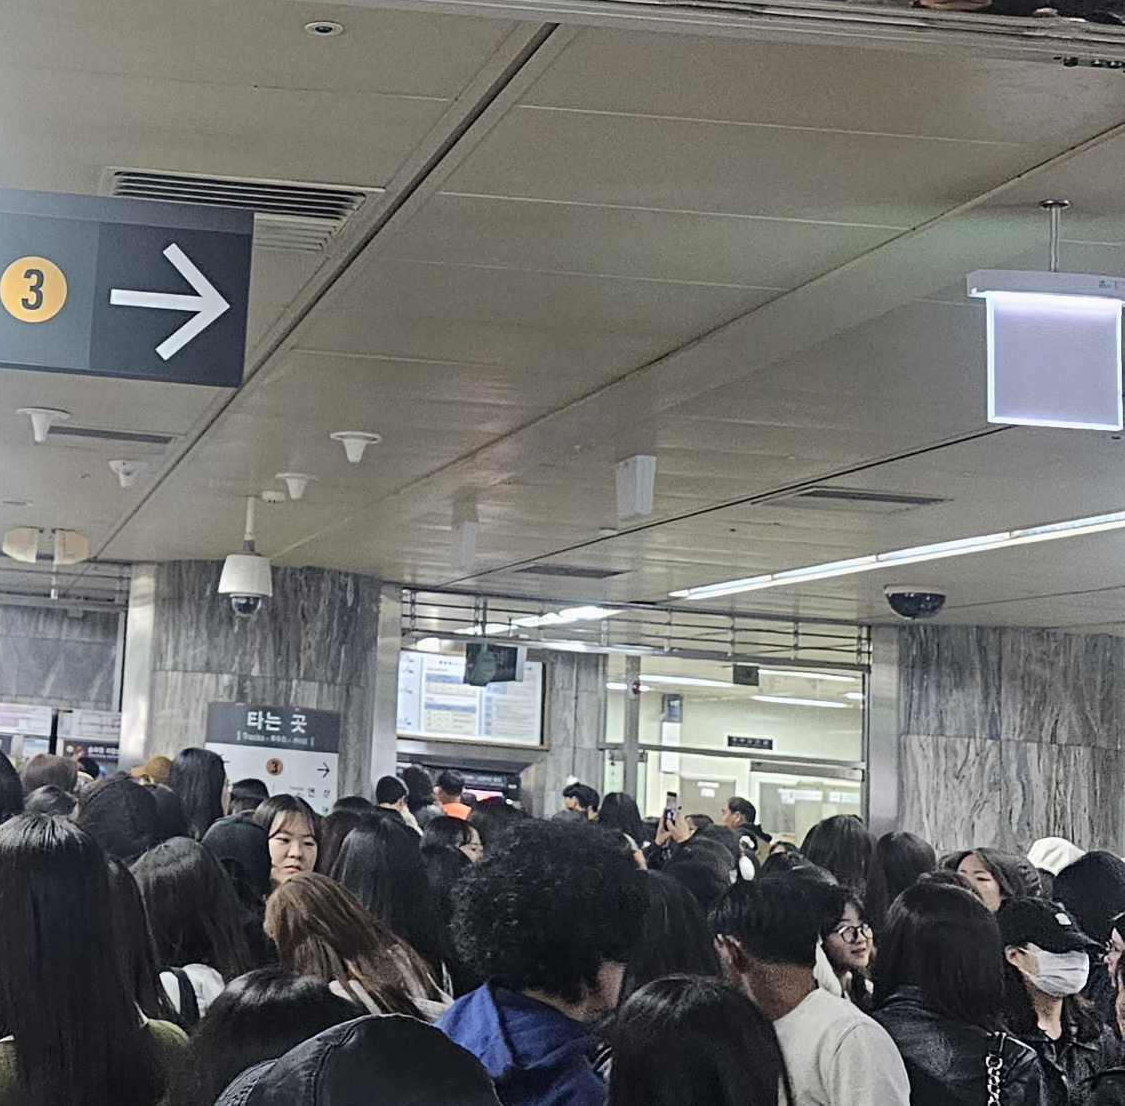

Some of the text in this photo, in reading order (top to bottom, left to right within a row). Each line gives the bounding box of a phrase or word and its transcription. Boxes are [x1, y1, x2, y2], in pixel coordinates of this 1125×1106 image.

[21, 268, 44, 310] 3
[246, 710, 308, 734] 타는 곳
